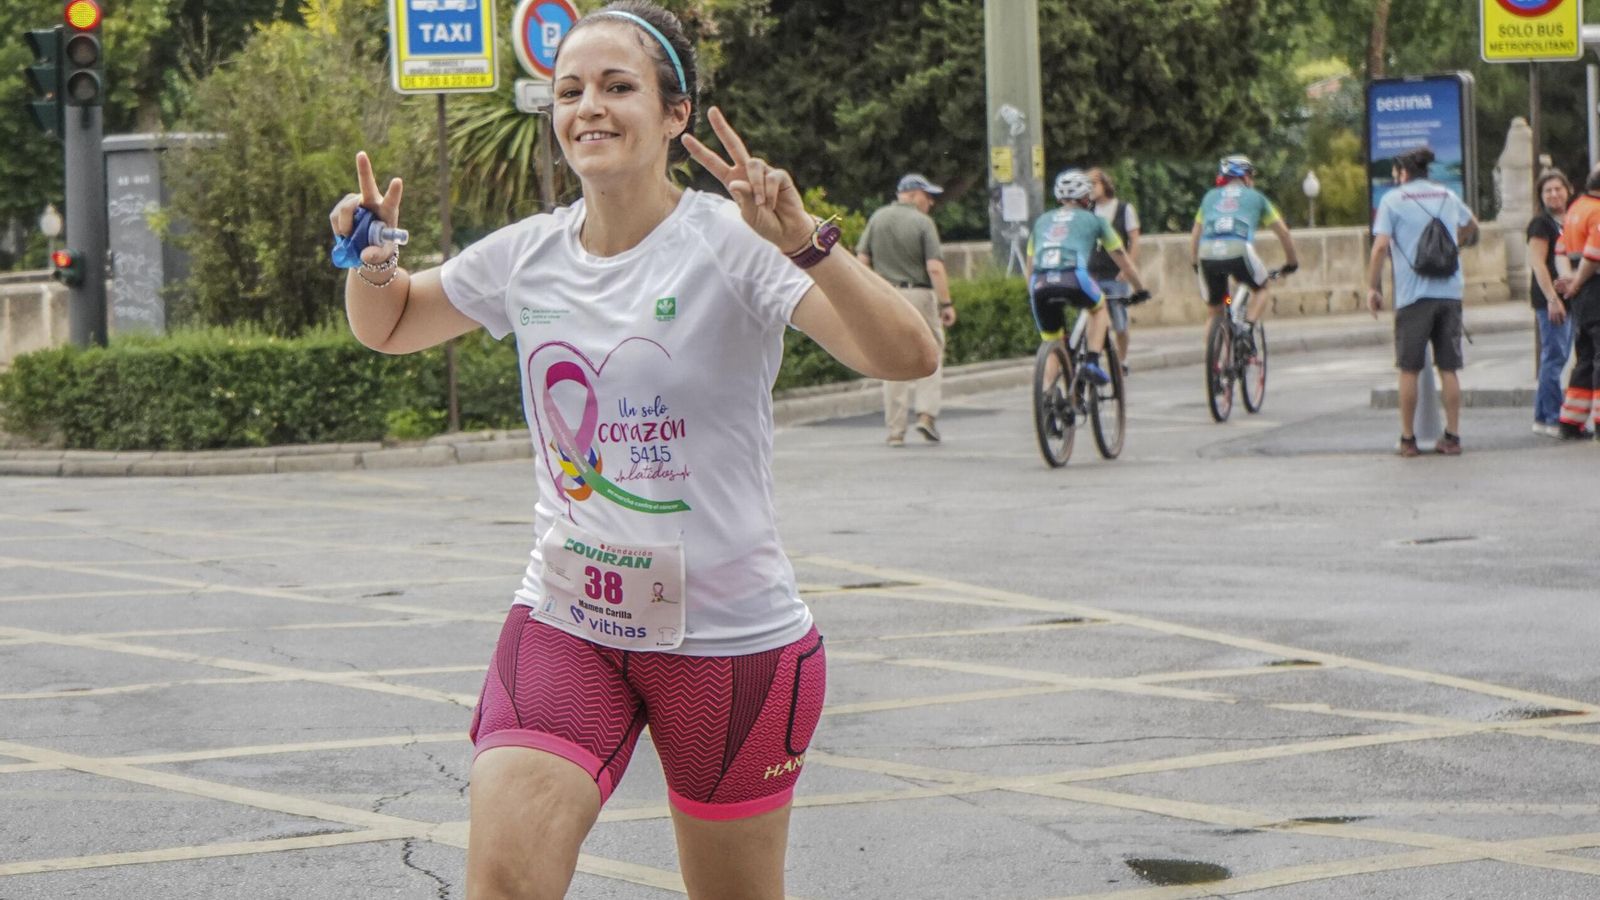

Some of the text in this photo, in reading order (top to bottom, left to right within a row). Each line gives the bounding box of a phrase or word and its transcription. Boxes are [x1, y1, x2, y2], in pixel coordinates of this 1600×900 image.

[418, 23, 472, 43] TAXI
[1498, 22, 1564, 38] SOLO BUS
[1489, 41, 1574, 52] METROPOLITANO
[619, 395, 668, 418] Un solo
[598, 415, 686, 443] corazón
[630, 445, 672, 464] 5415
[627, 461, 676, 481] latidos
[606, 545, 652, 557] Fundación
[584, 565, 623, 605] 38
[578, 599, 632, 620] Mamen Carilla
[588, 617, 647, 638] vithas
